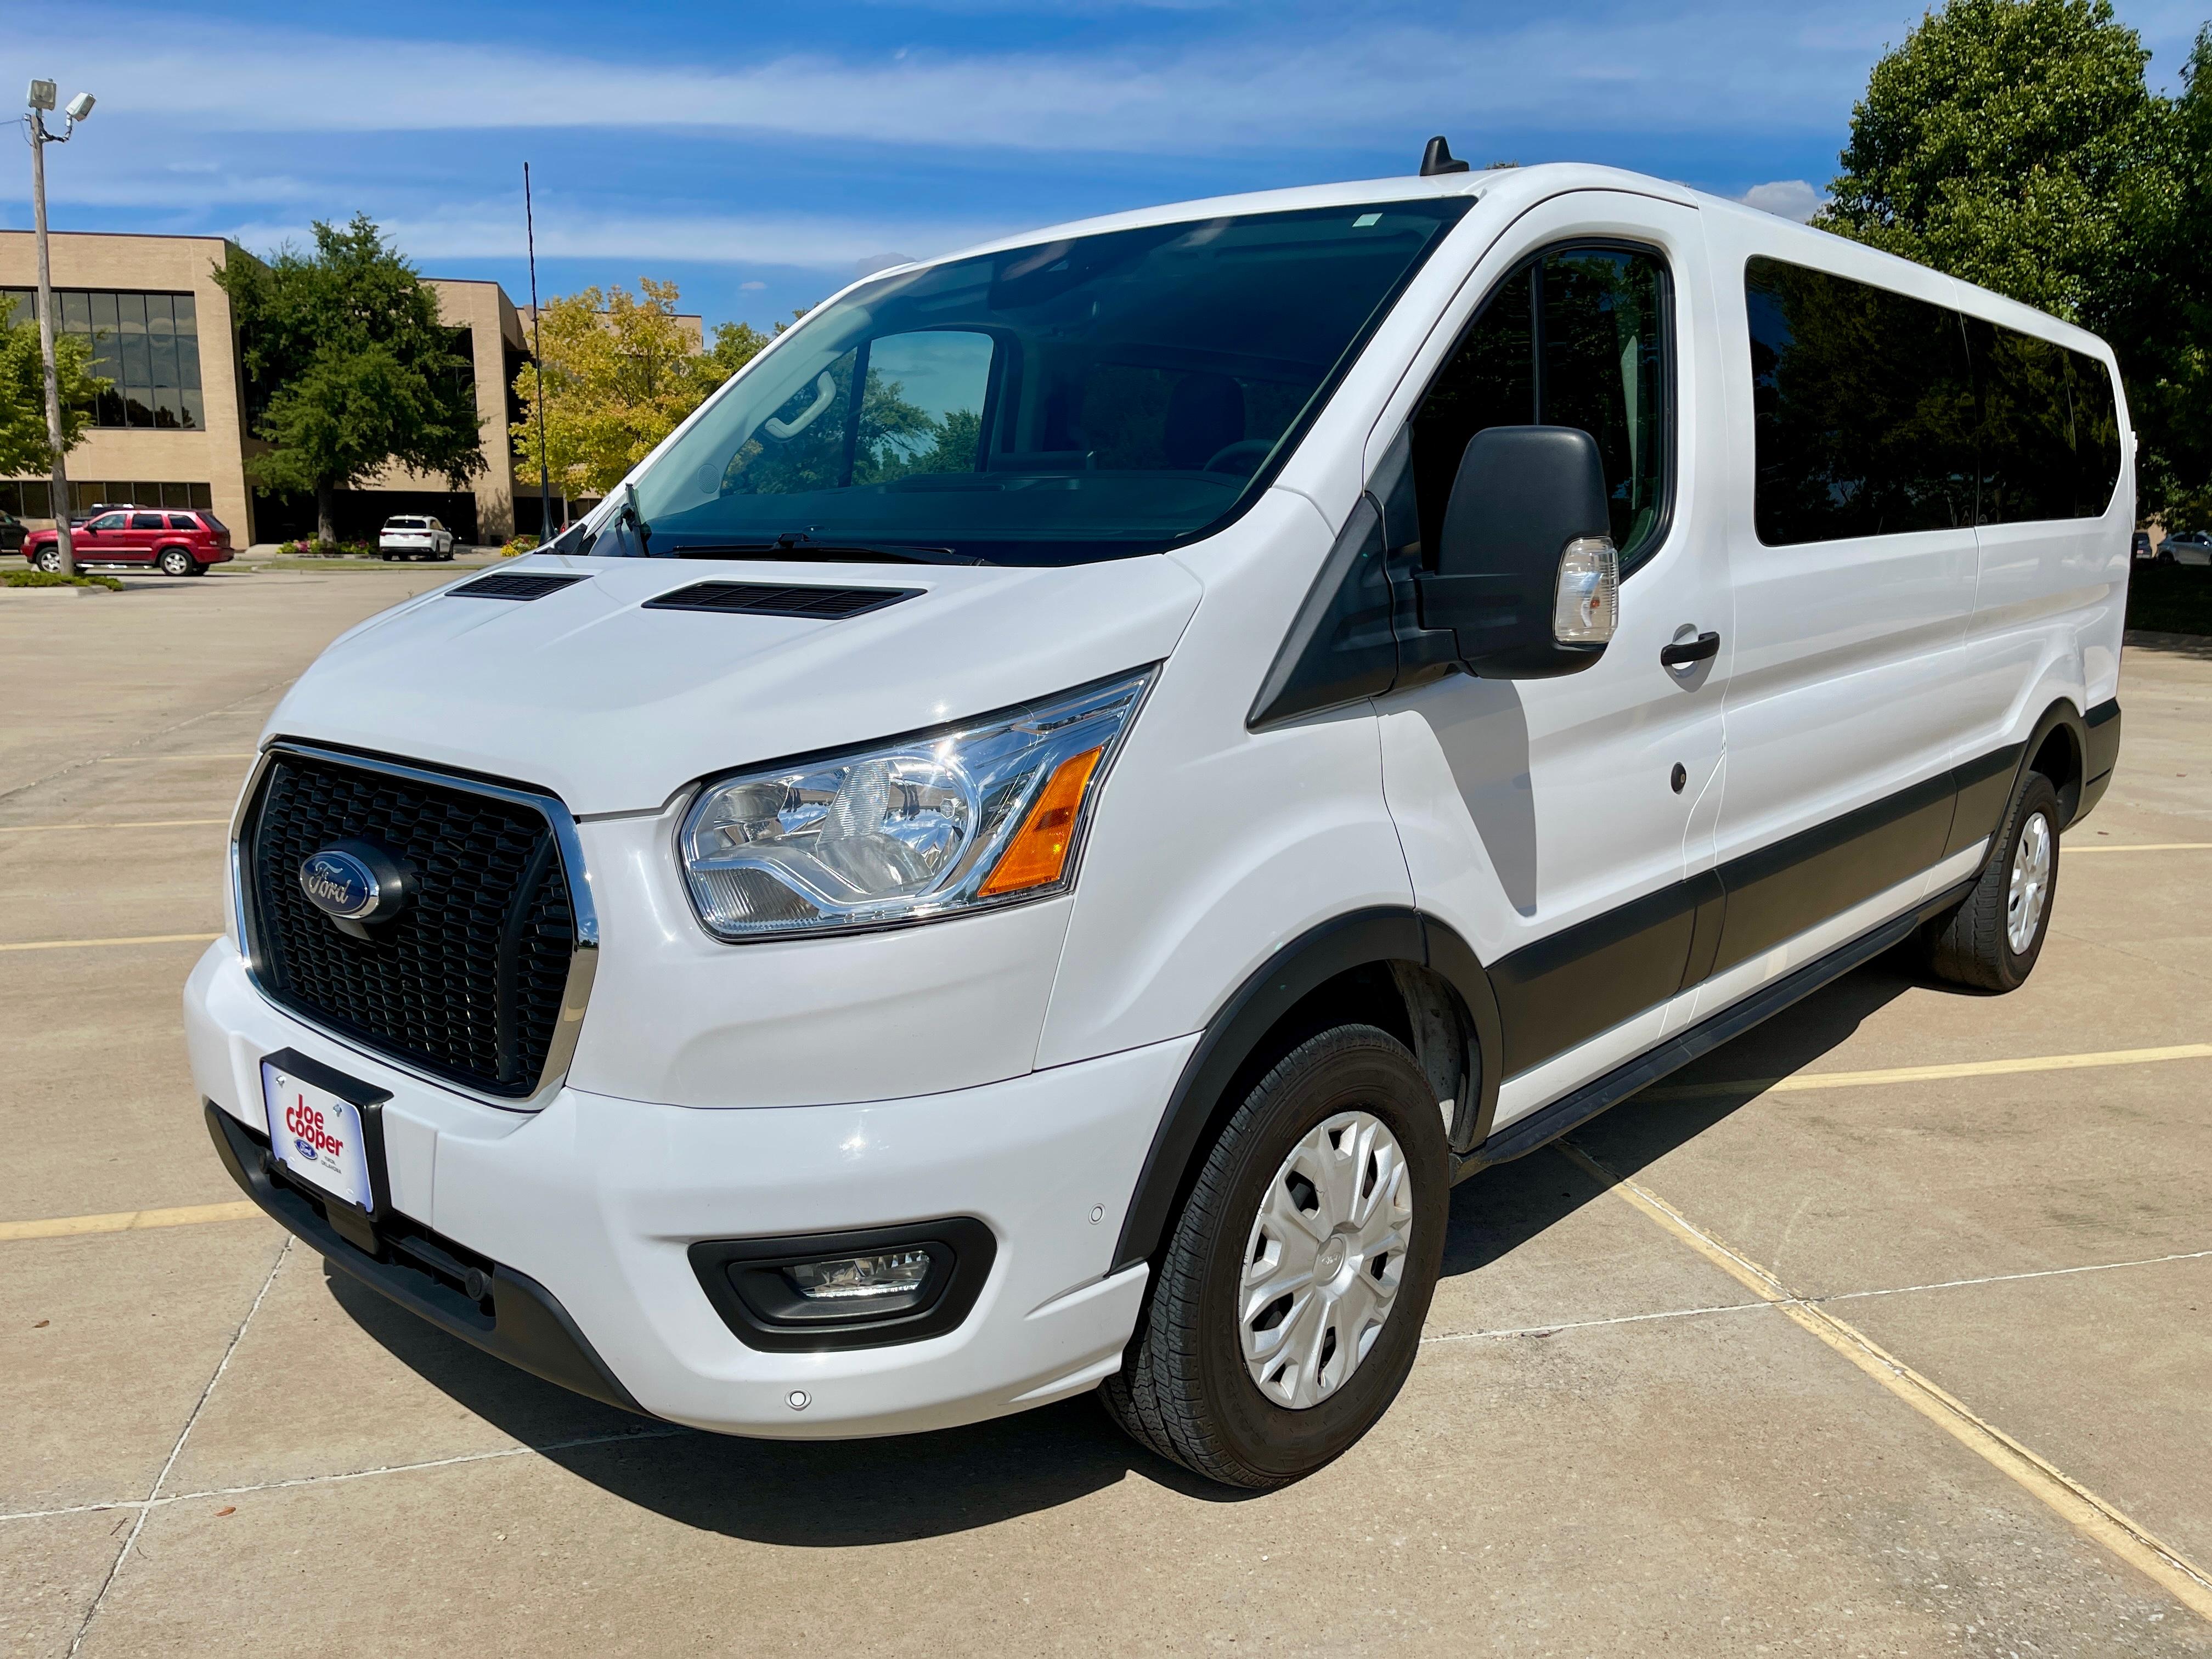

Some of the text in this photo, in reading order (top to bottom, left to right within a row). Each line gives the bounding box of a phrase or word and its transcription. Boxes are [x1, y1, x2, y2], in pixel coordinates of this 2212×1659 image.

[309, 860, 352, 904] Ford
[286, 1106, 343, 1157] Cooper
[296, 1093, 324, 1130] Joe
